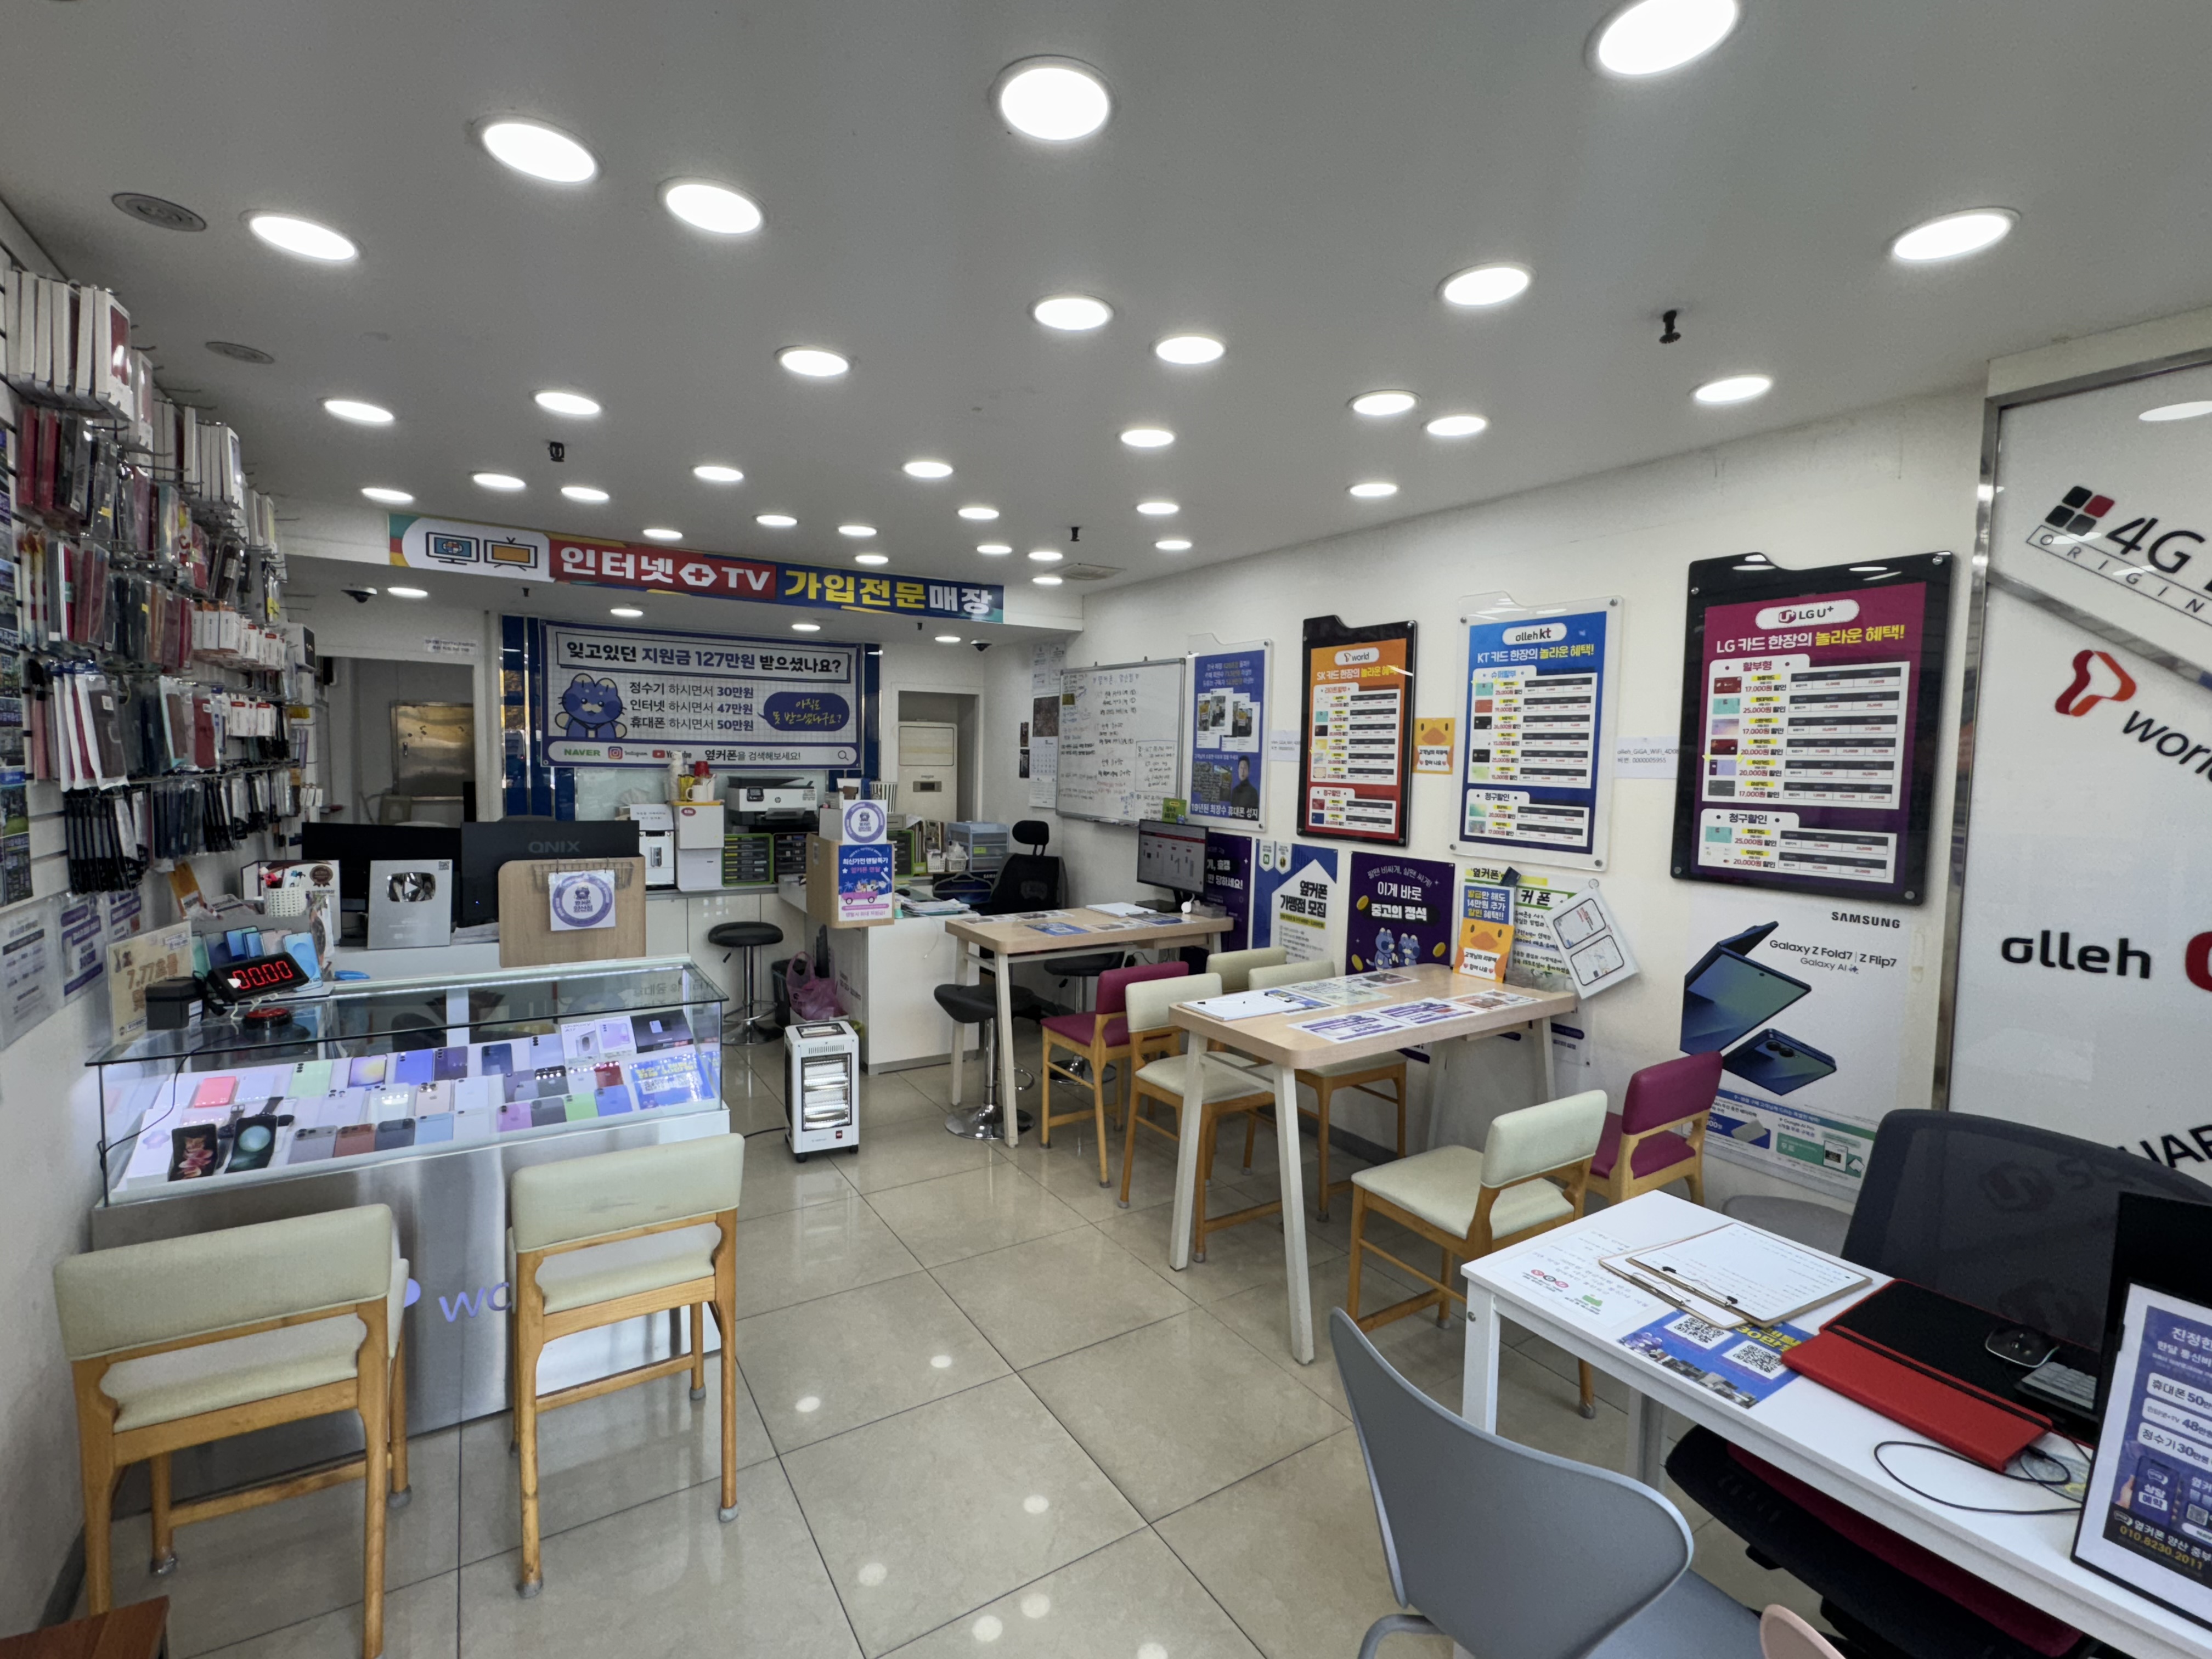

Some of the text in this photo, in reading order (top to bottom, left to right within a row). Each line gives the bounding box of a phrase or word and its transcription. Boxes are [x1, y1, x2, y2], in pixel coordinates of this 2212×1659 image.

[560, 547, 770, 591] 인터넷 TV
[1798, 610, 1814, 621] LG
[1515, 628, 1552, 642] olleh kt
[1717, 624, 1905, 653] LG 카드 한장의 놀라운 혜택!
[567, 641, 842, 673] 잊고있던 지원금 127만원 받으셨나요?
[1352, 652, 1369, 662] world
[1477, 644, 1594, 663] KT 카드 한장의 놀라운 혜택!
[1317, 672, 1326, 680] SK
[1326, 669, 1340, 680] 카드
[1743, 661, 1772, 672] 할부형
[630, 681, 754, 698] 정수기 하시면서 30만원
[630, 699, 754, 715] 인터넷 하시면서 47만원
[630, 716, 754, 732] 휴대폰 하시면서 50만원
[564, 748, 601, 757] NAVER
[748, 751, 801, 761] 검색해보세요!
[2123, 710, 2212, 783] worl
[1191, 803, 1209, 814] 19년된
[1228, 806, 1245, 817] 휴대폰
[1246, 808, 1258, 819] 성지
[1729, 813, 1768, 825] 청구할인
[1300, 880, 1328, 900] 옆커폰
[1377, 881, 1422, 901] 이게 바로
[1491, 891, 1506, 902] 해도
[1280, 894, 1327, 919] 가맹점 모집
[1371, 903, 1427, 922] 중고의 정석
[1467, 899, 1506, 911] 14만원 추가
[1831, 911, 1901, 929] SAMSUNG
[1769, 940, 1897, 969] Galaxy Z Fold7 Z Flip7
[2001, 930, 2151, 979] olleh
[1800, 957, 1847, 972] Galaxy AI
[2152, 1379, 2186, 1400] 휴대폰
[2142, 1428, 2176, 1451] 정수기
[2168, 1535, 2188, 1552] 양산
